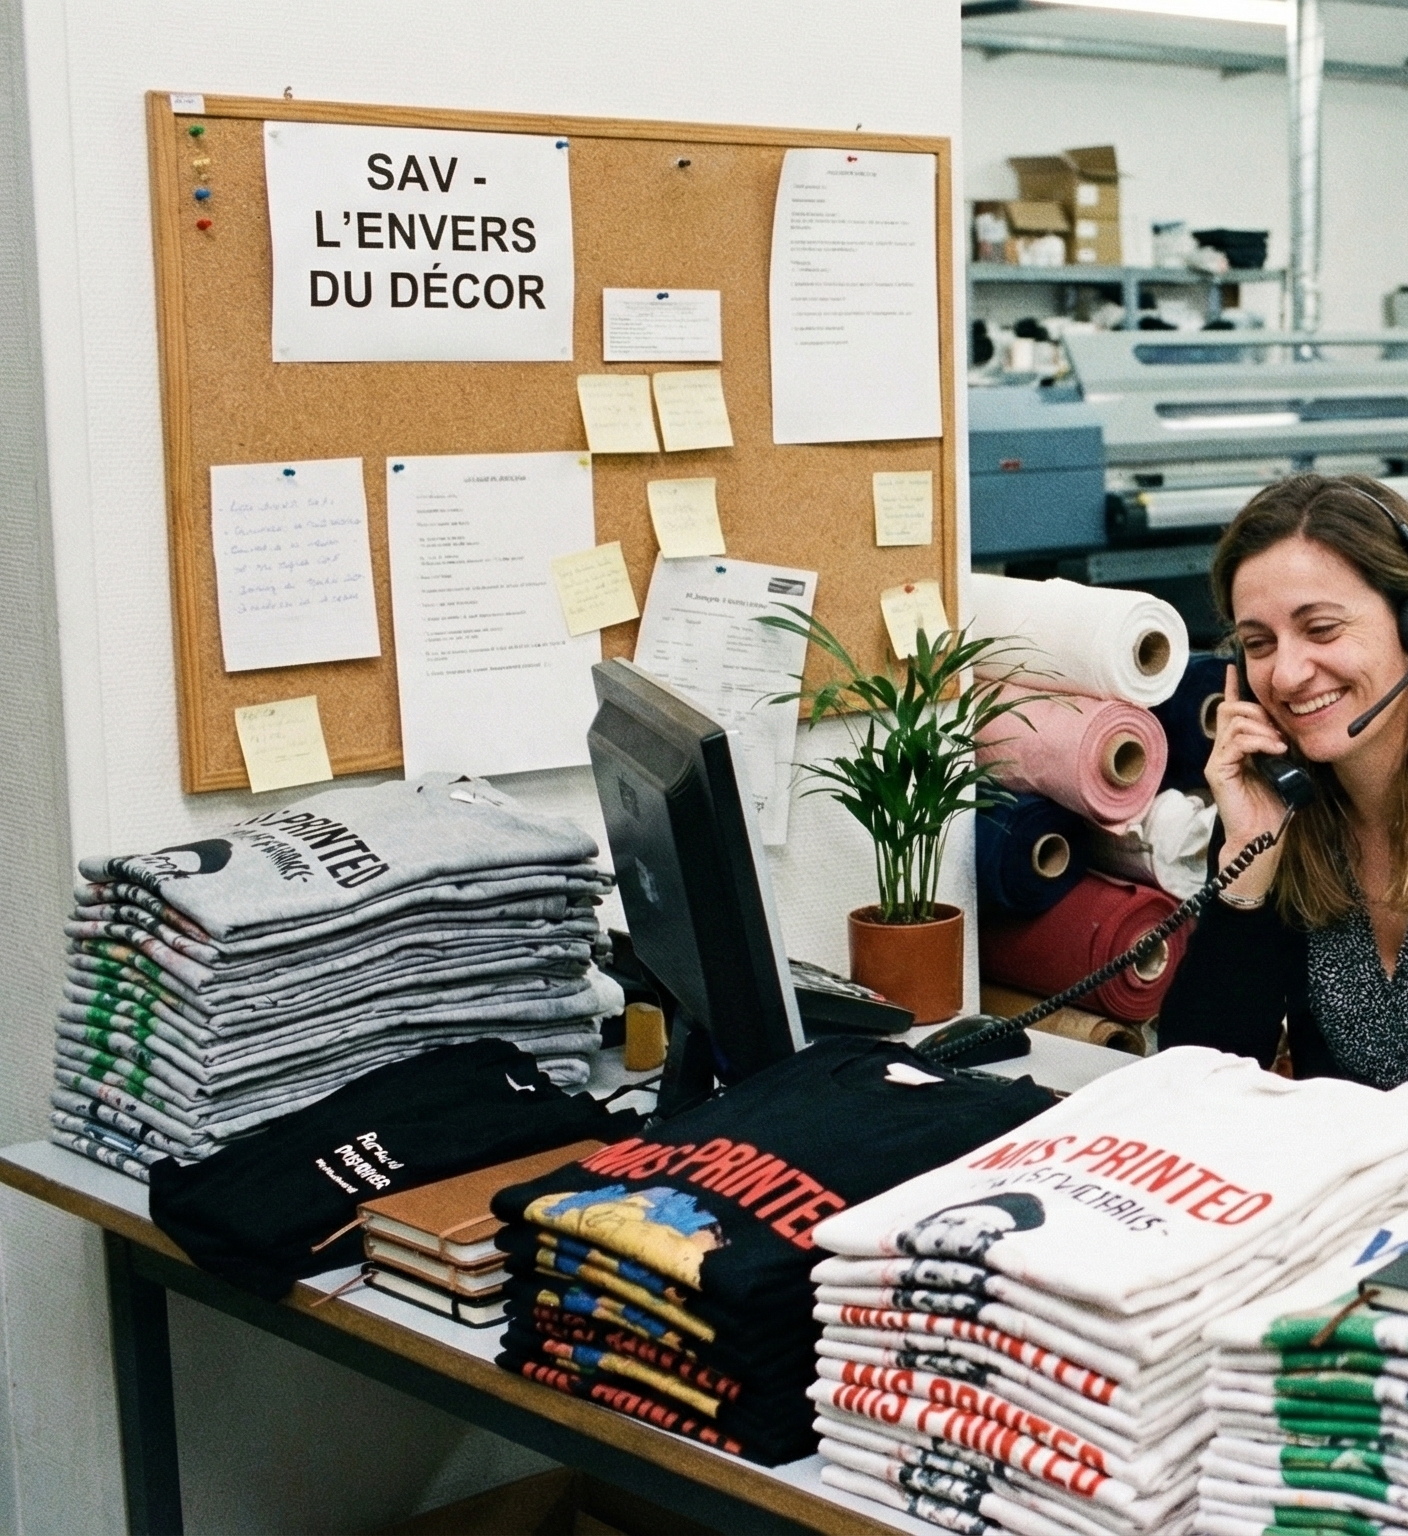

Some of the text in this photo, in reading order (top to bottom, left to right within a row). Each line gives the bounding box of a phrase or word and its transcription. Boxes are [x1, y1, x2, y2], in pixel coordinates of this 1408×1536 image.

[367, 152, 487, 193] SAV -
[315, 210, 537, 253] L'ENVERS
[310, 262, 547, 310] DU DÉCOR
[260, 812, 391, 889] PRINTED
[967, 1135, 1077, 1171] MIS
[1061, 1135, 1273, 1226] PRINTED
